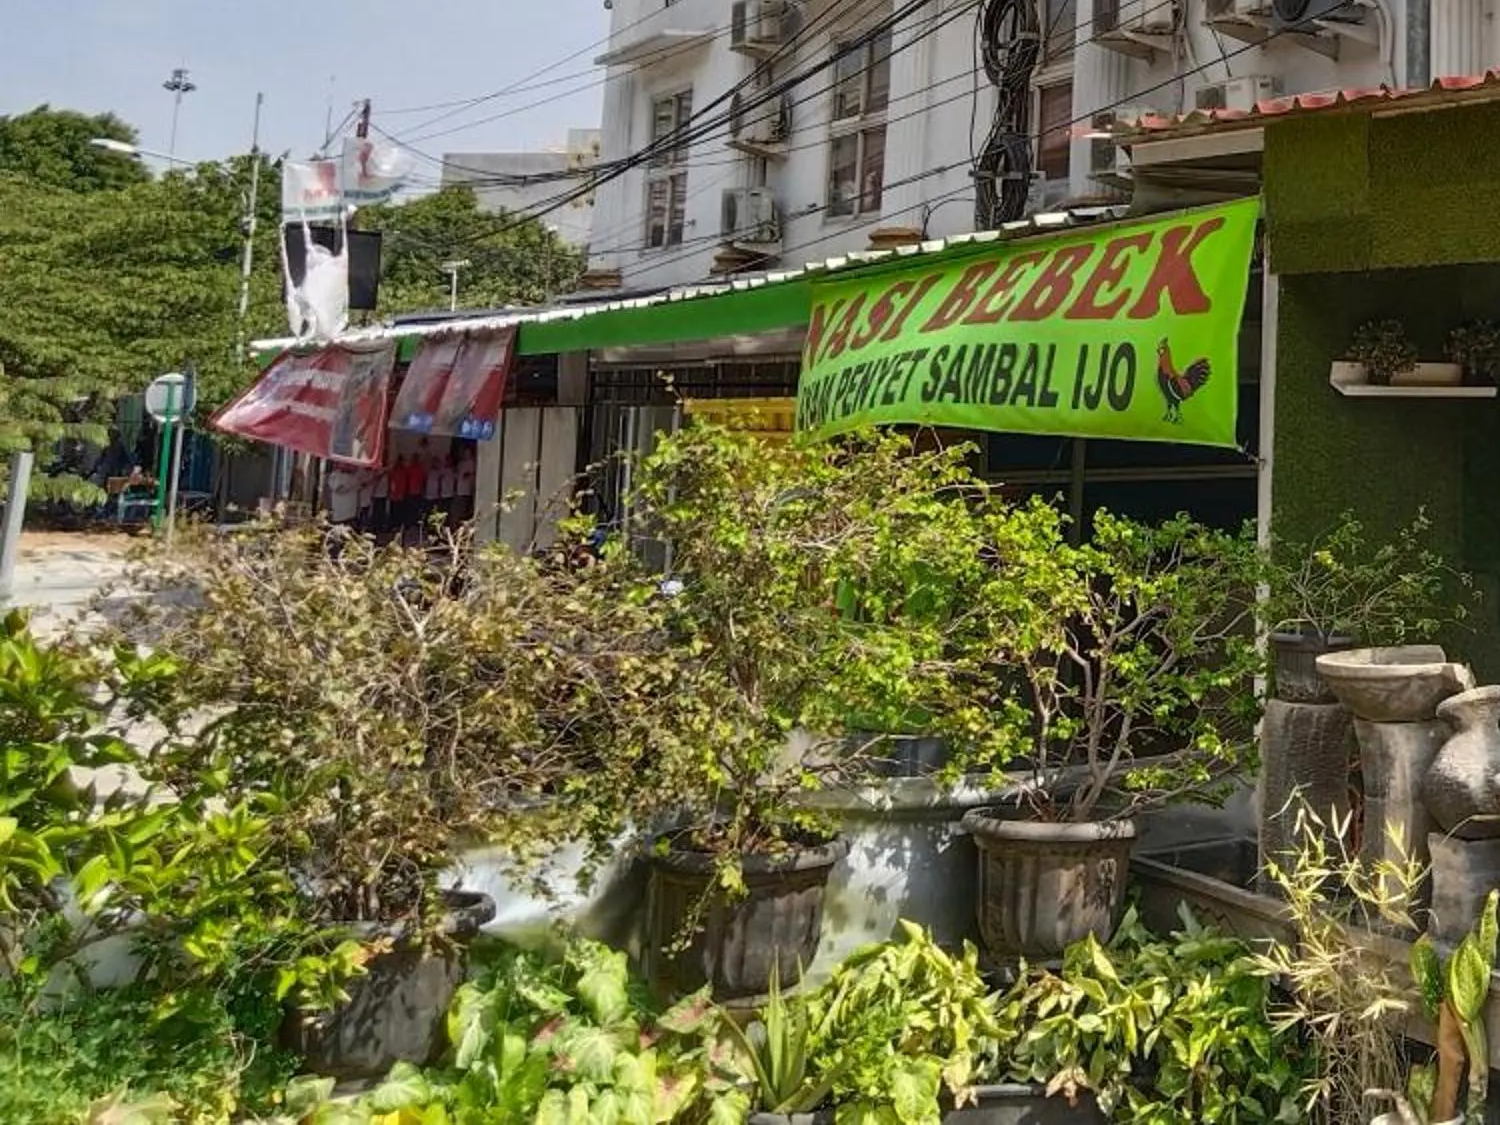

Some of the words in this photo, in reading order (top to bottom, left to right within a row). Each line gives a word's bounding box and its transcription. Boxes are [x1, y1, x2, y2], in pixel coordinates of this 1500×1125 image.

[807, 273, 945, 370] NASI
[920, 217, 1224, 335] BEBEK
[831, 347, 930, 421] PENYET
[921, 342, 1059, 409] SAMBAL
[1071, 341, 1137, 413] IJO
